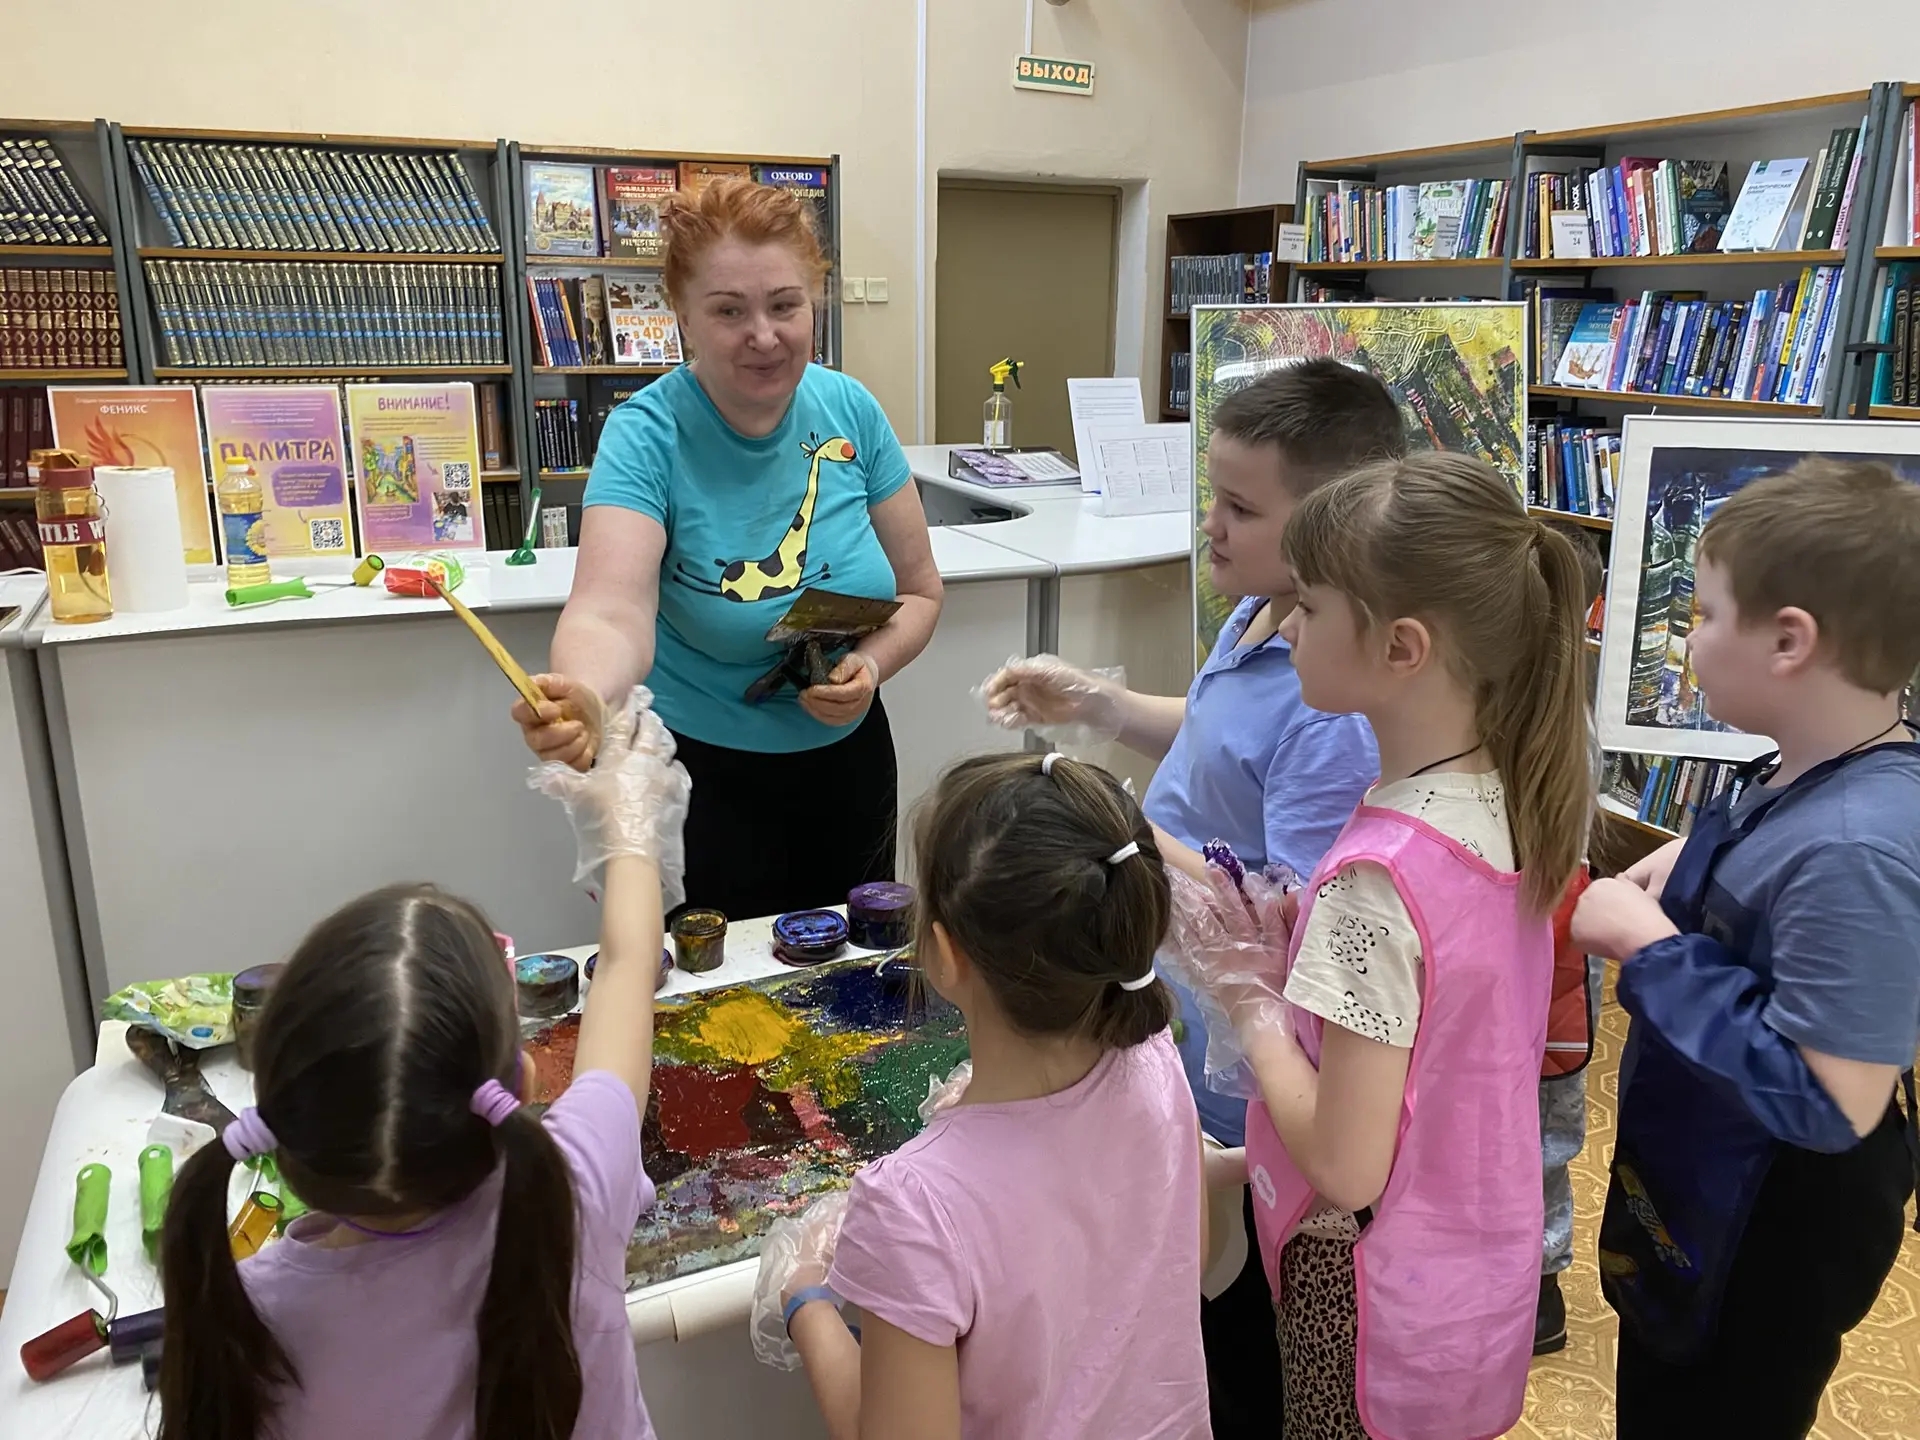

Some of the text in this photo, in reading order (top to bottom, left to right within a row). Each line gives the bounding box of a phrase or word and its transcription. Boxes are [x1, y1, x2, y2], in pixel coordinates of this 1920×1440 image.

[1019, 60, 1089, 85] ВЫХОД
[770, 171, 813, 181] OXFORD
[1825, 193, 1836, 208] 2
[1572, 237, 1581, 246] 24
[615, 315, 674, 326] ВЕСЬ МИР
[643, 326, 665, 340] 4D
[377, 391, 451, 411] ВНИМАНИЕ!
[99, 404, 149, 415] ФЕНИКС
[219, 439, 336, 463] ПАЛИТРА
